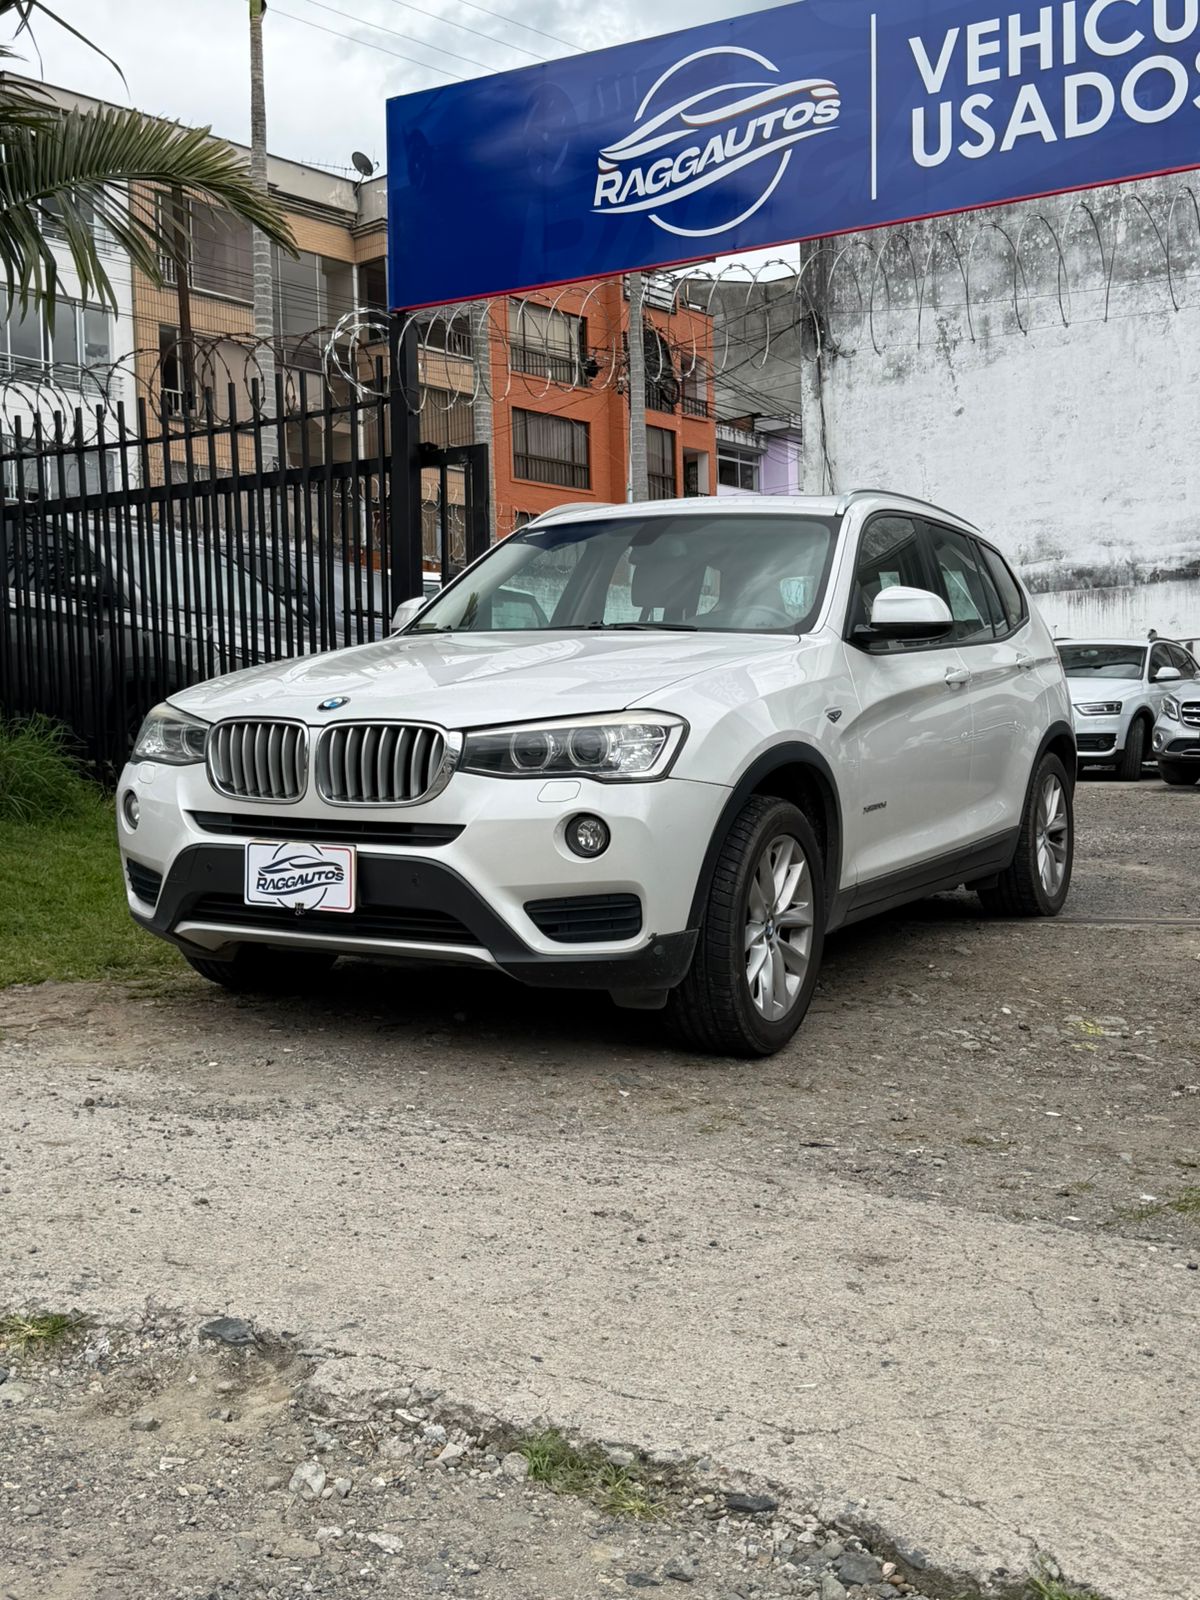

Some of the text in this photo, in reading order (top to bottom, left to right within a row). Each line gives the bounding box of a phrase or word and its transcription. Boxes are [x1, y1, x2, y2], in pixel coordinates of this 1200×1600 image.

[908, 0, 1199, 95] VEHICU
[593, 98, 841, 207] RAGGAUTOS
[911, 52, 1200, 168] USADO
[256, 870, 345, 891] RAGGAUTOS
